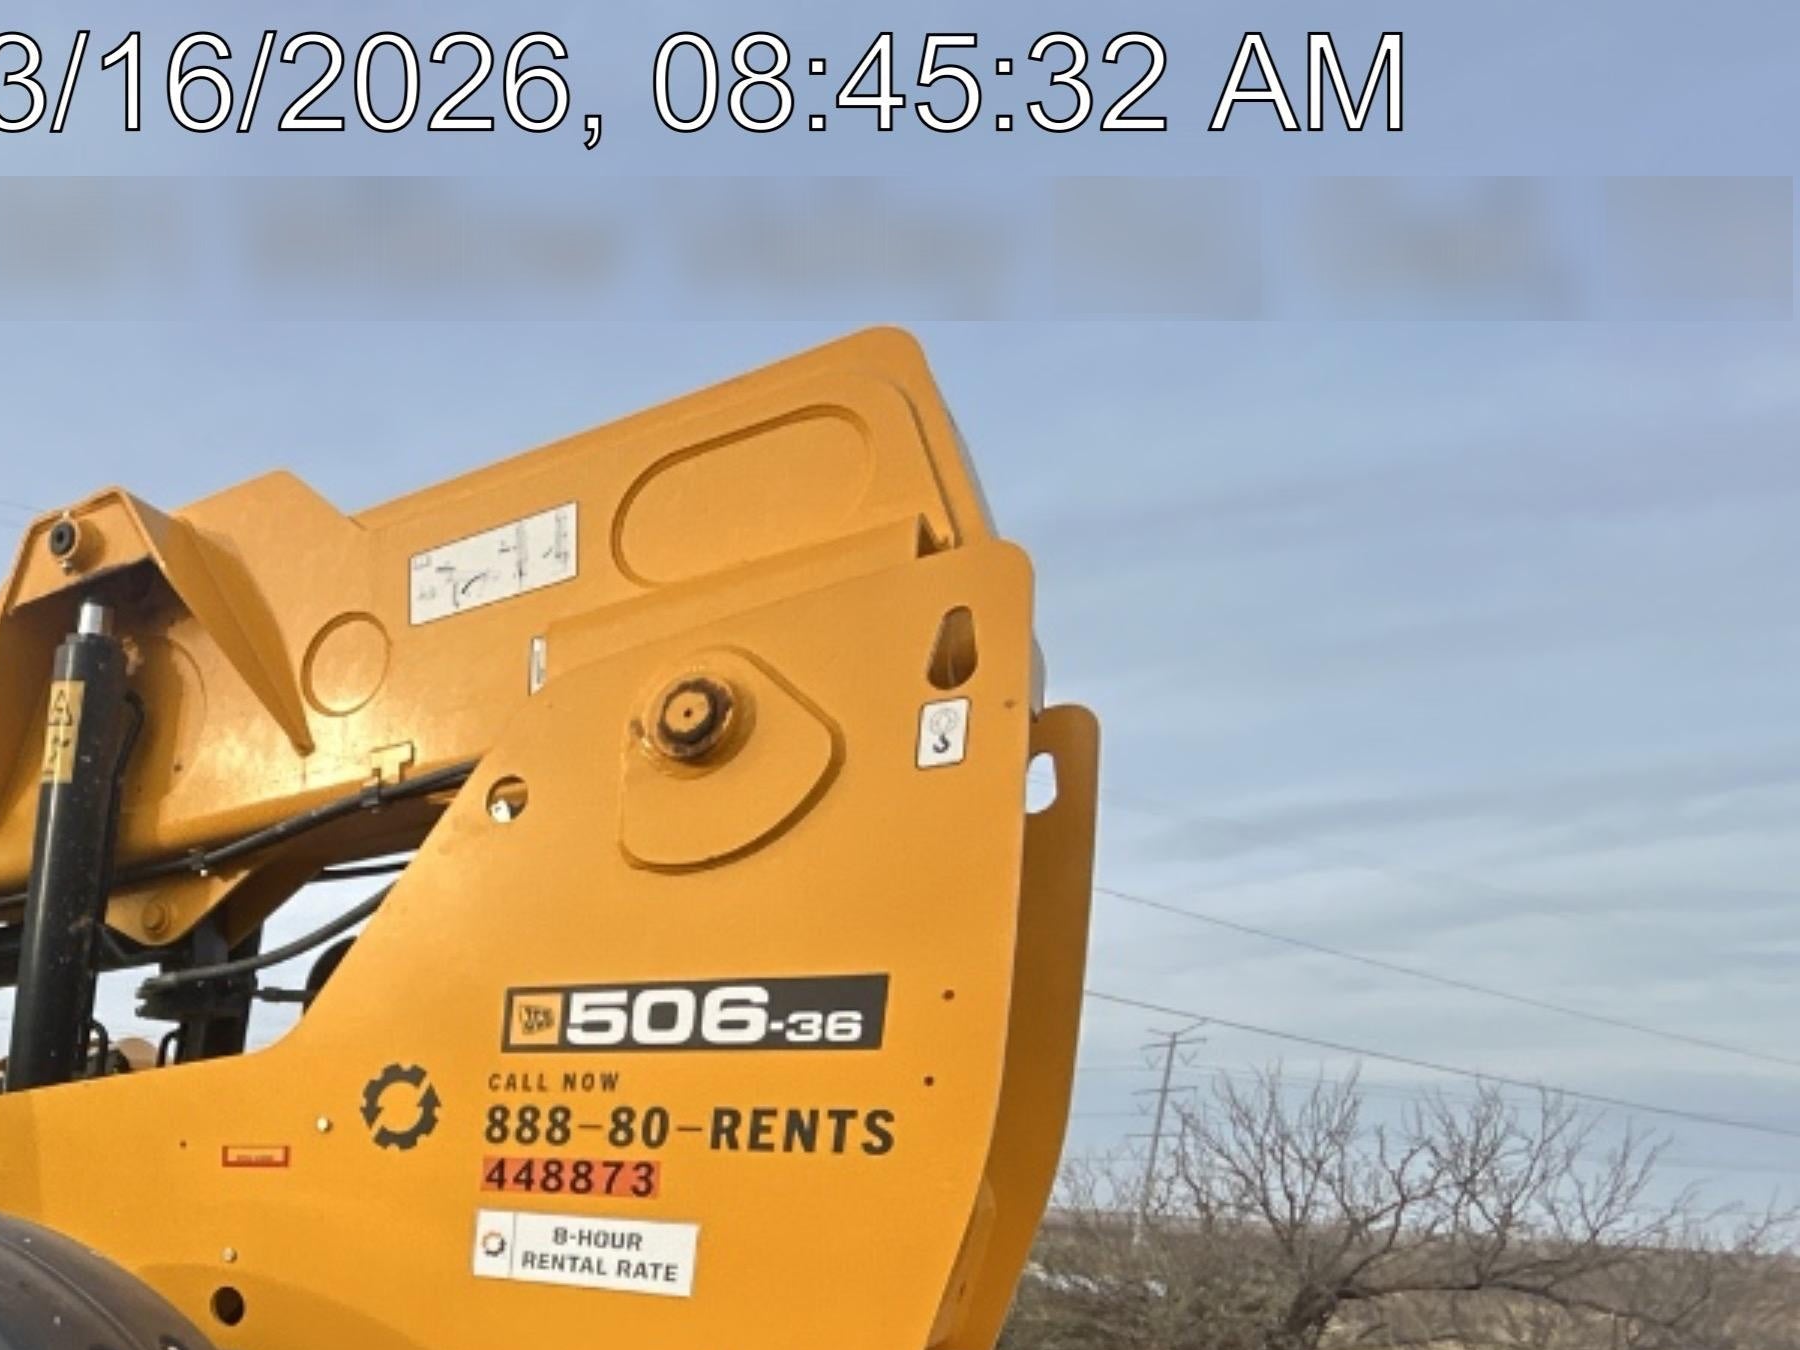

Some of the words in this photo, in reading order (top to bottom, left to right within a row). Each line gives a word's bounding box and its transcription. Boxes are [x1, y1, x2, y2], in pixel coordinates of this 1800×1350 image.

[566, 985, 864, 1045] 506-36
[488, 1072, 548, 1093] CALL
[563, 1071, 620, 1093] NOW
[484, 1103, 895, 1155] 888-80-RENTS
[485, 1157, 656, 1198] 448873
[552, 1226, 644, 1252] 8-HOUR
[520, 1250, 609, 1277] RENTAL
[616, 1258, 679, 1283] RATE
